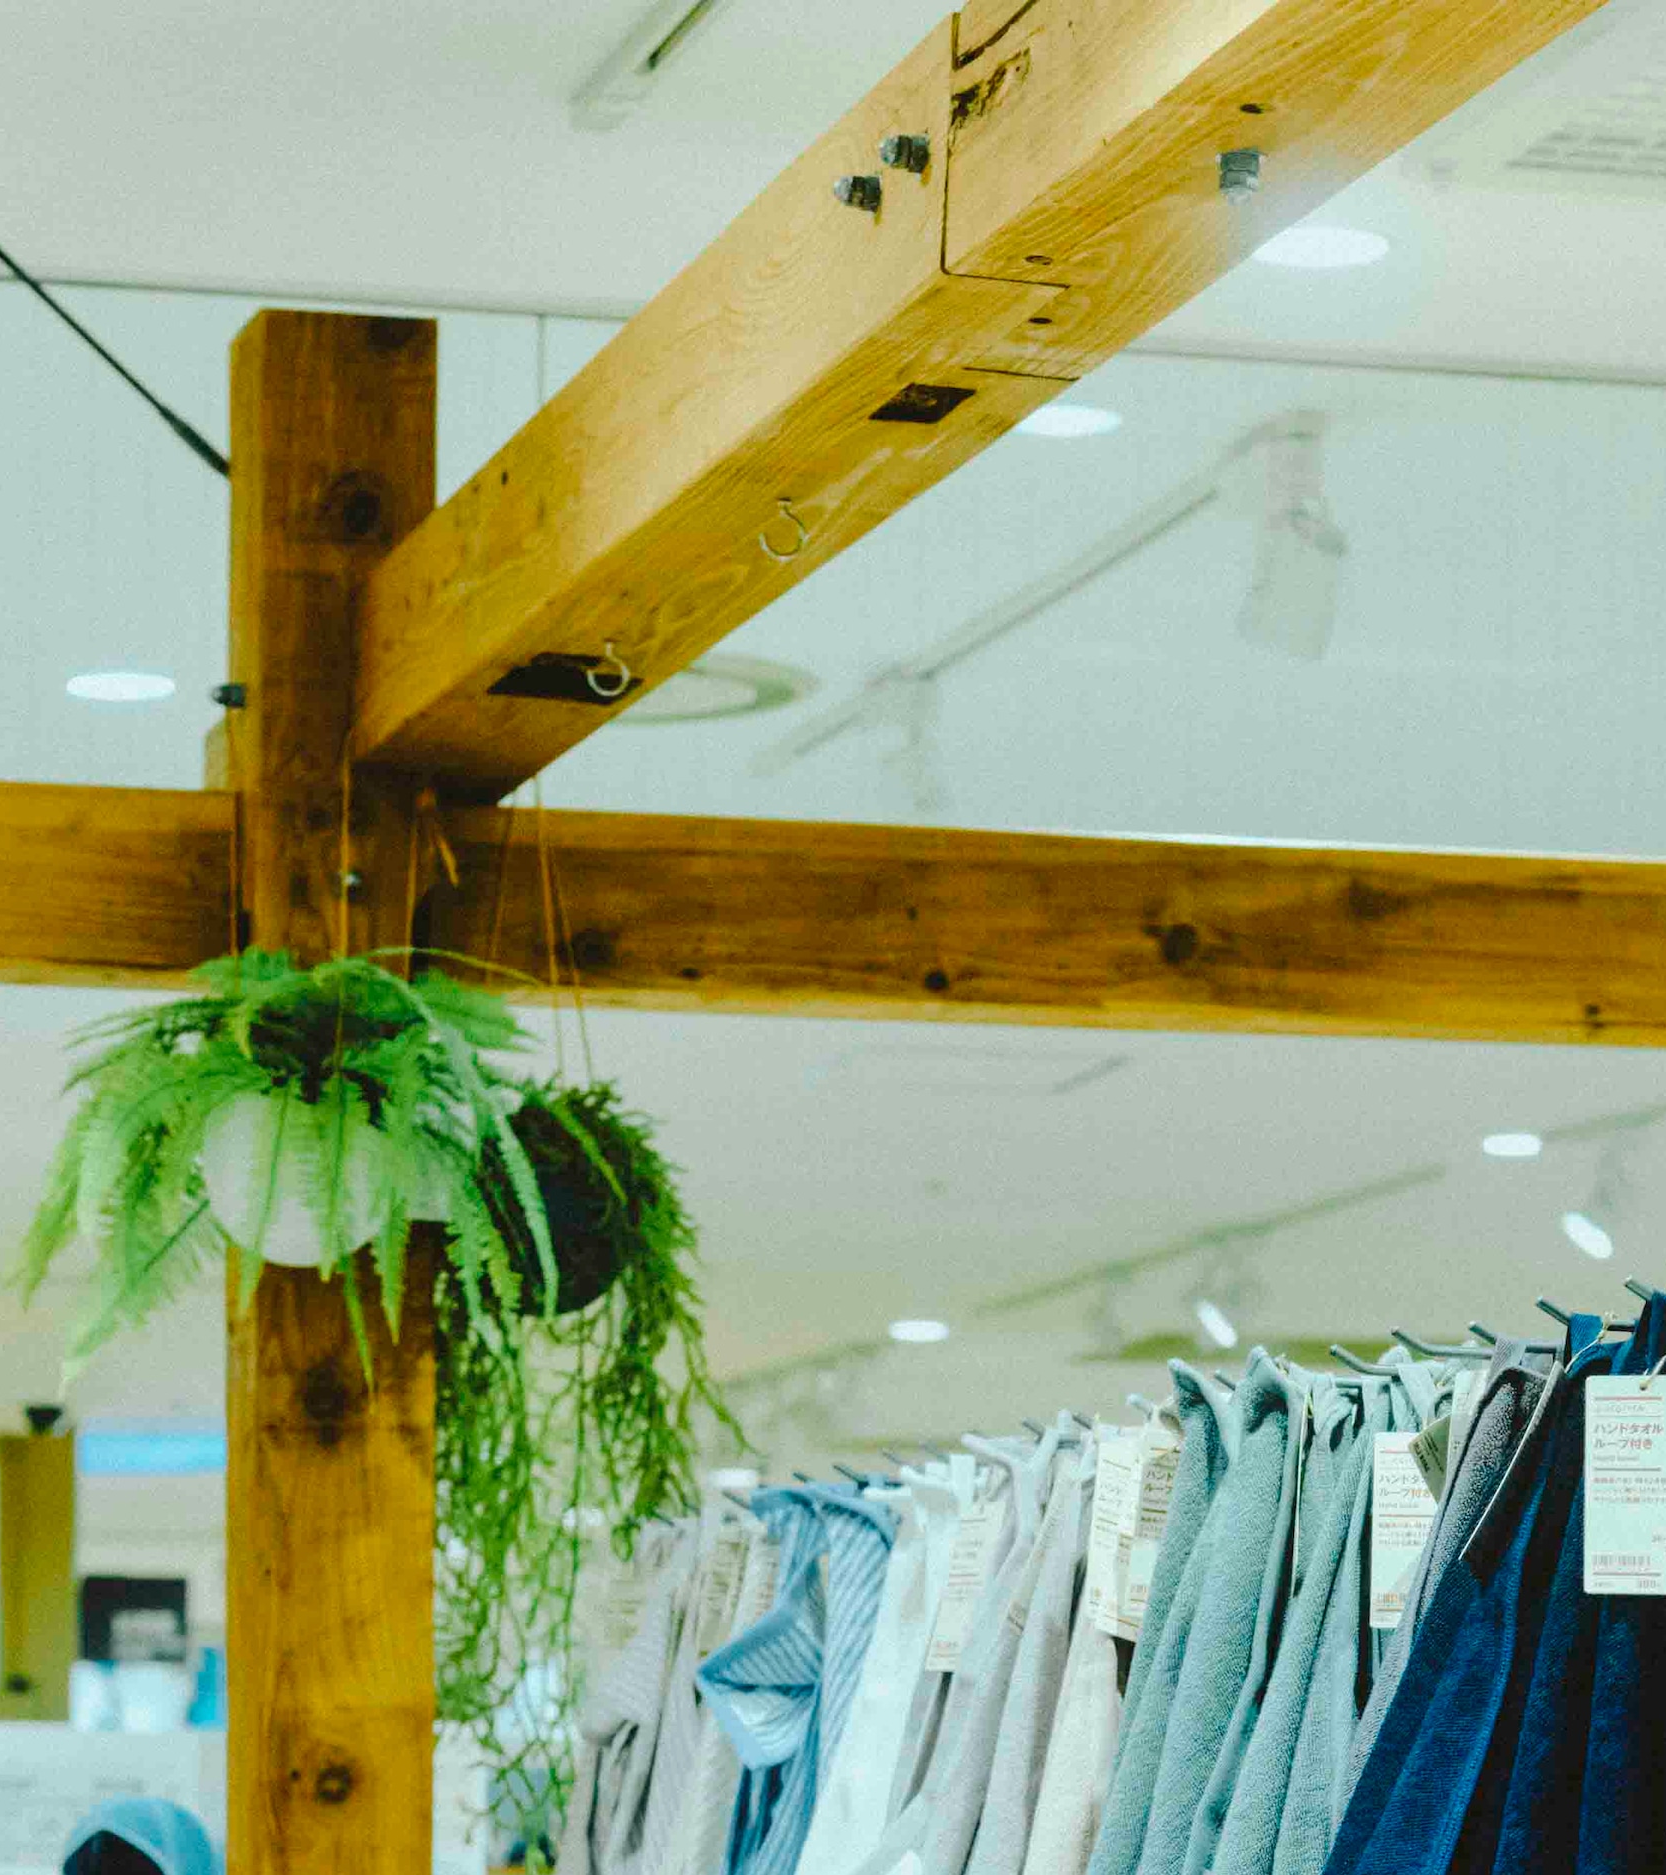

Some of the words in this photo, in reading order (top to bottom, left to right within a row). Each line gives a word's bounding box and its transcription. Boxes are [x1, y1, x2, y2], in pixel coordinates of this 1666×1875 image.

[1593, 1422, 1664, 1434] ハンドタオル
